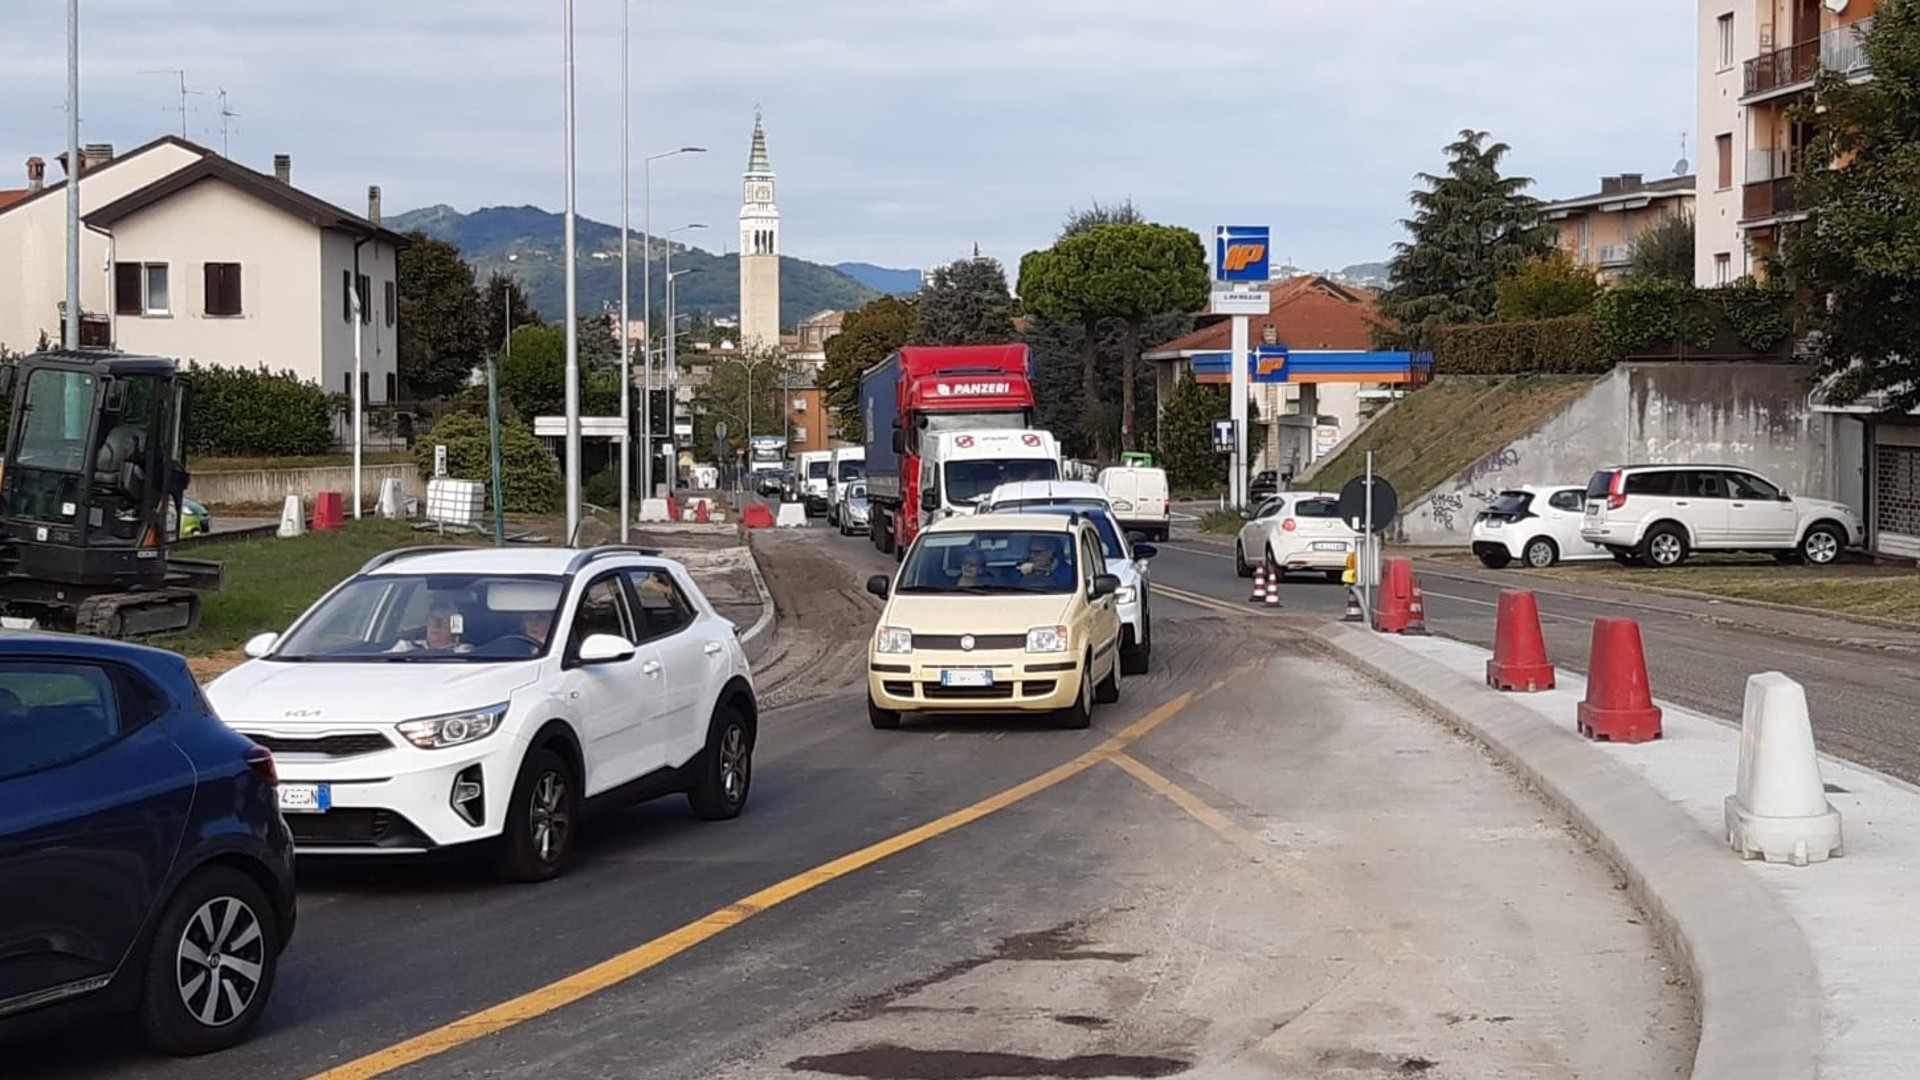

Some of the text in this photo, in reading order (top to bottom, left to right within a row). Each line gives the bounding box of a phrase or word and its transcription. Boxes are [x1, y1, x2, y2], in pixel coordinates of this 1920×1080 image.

[1223, 244, 1265, 270] IP
[1257, 357, 1284, 374] IP
[953, 383, 1010, 394] PANZERI
